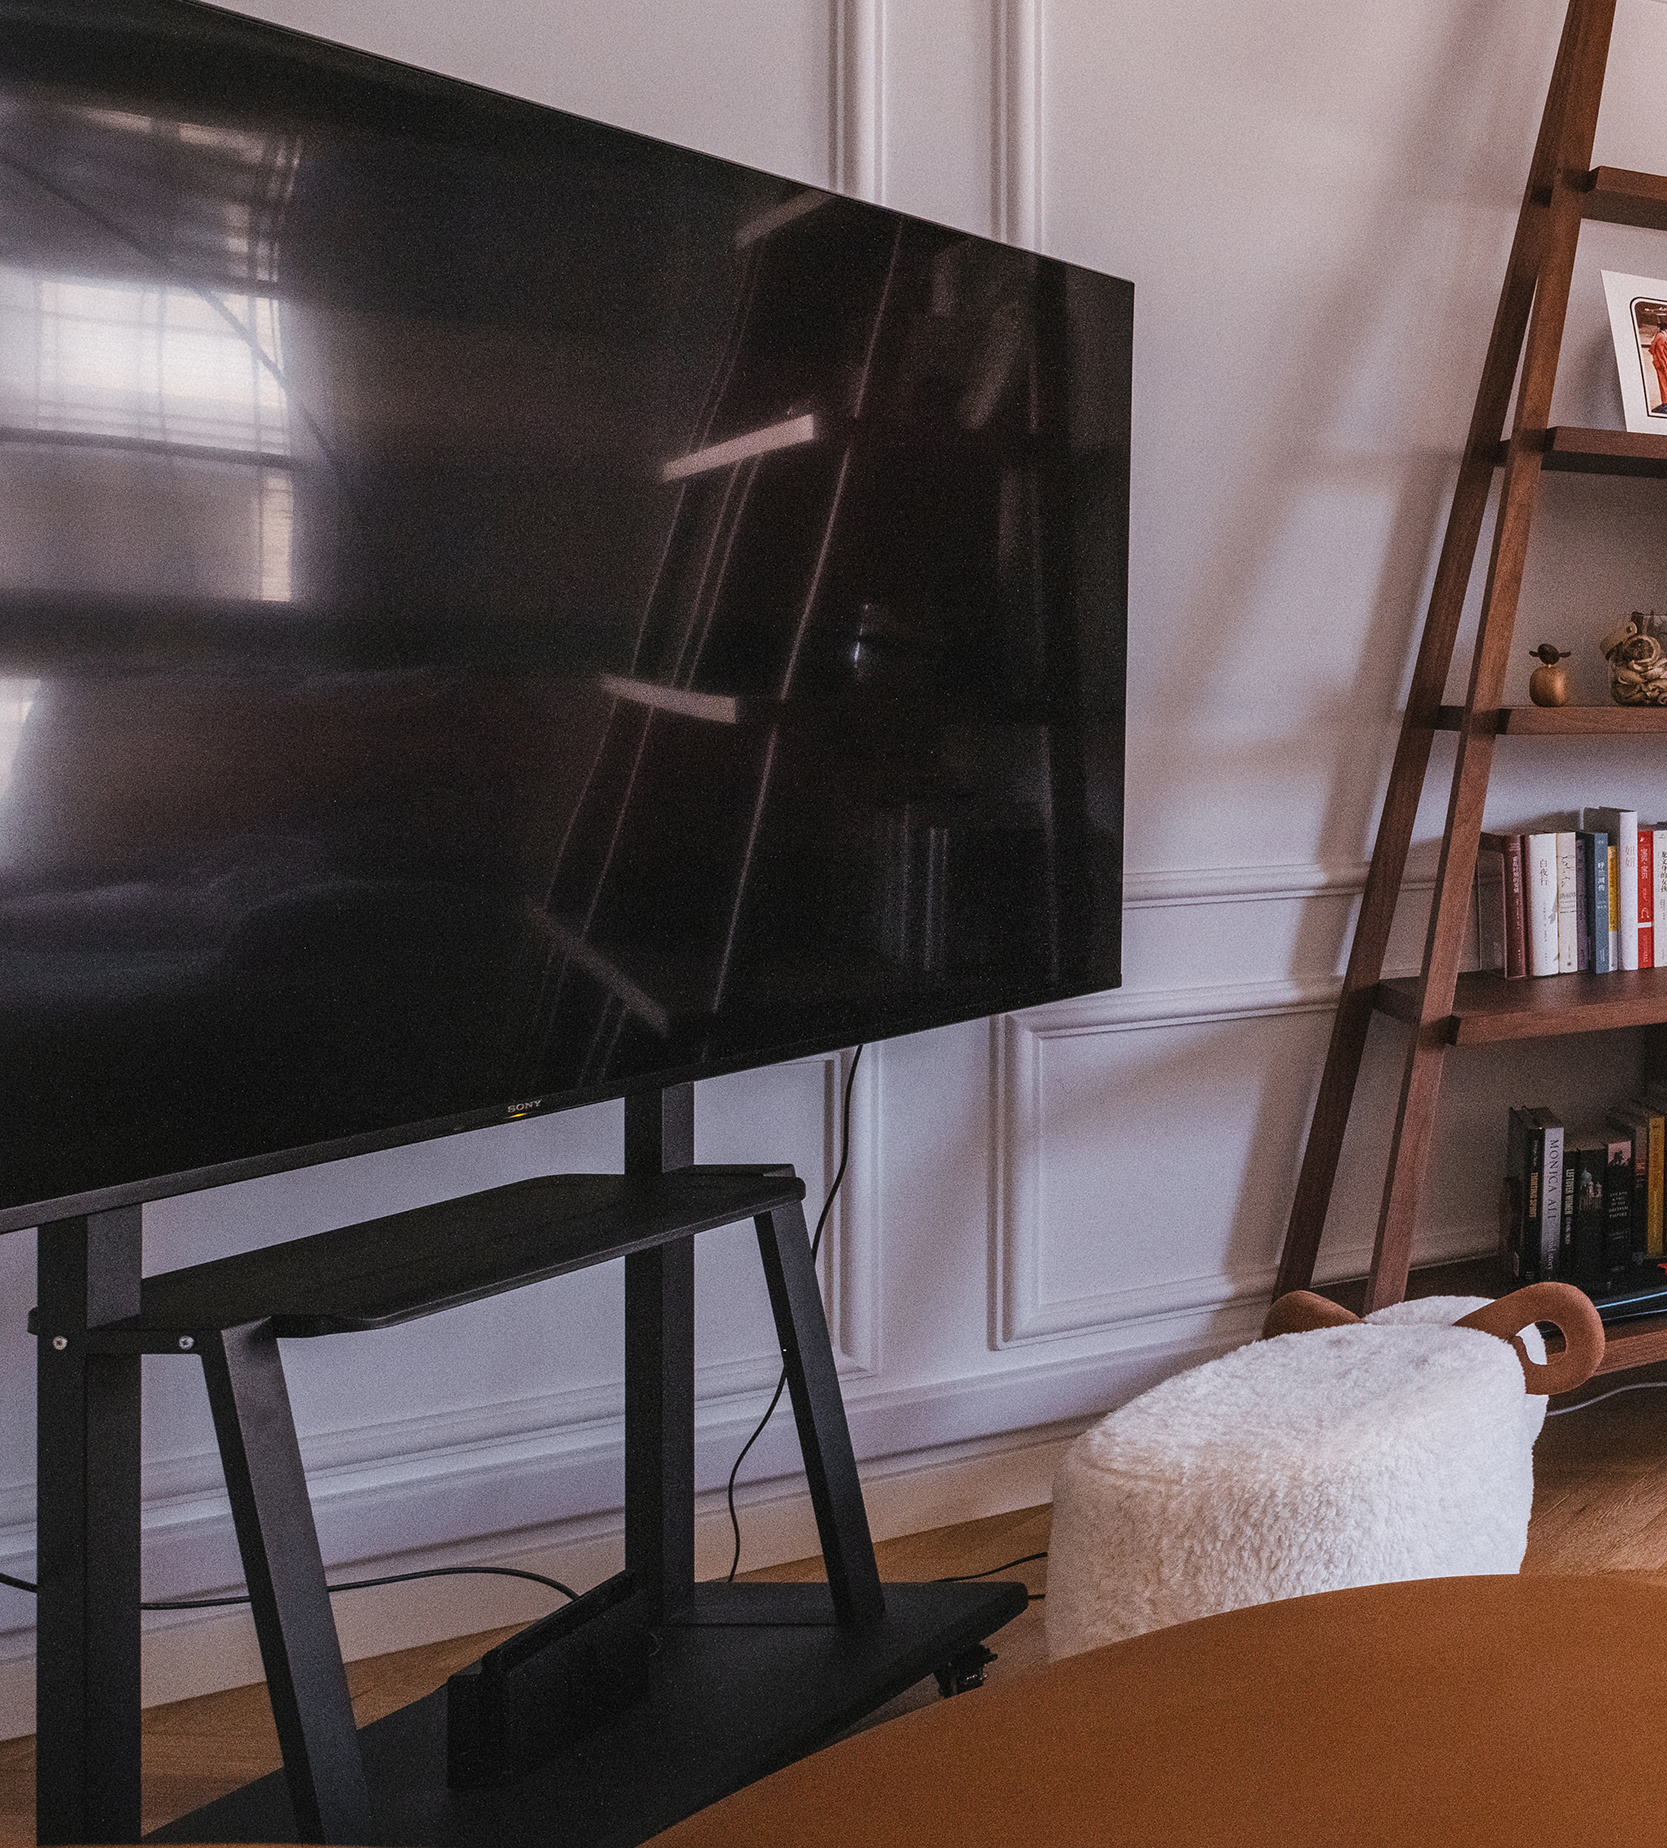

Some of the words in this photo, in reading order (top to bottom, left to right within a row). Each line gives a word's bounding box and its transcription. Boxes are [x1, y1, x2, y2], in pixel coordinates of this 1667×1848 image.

[1539, 858, 1548, 886] 白夜行
[1597, 861, 1606, 892] 呼兰河传
[507, 1099, 543, 1113] SONY
[1547, 1139, 1559, 1193] MONICA
[1547, 1199, 1557, 1219] ALI
